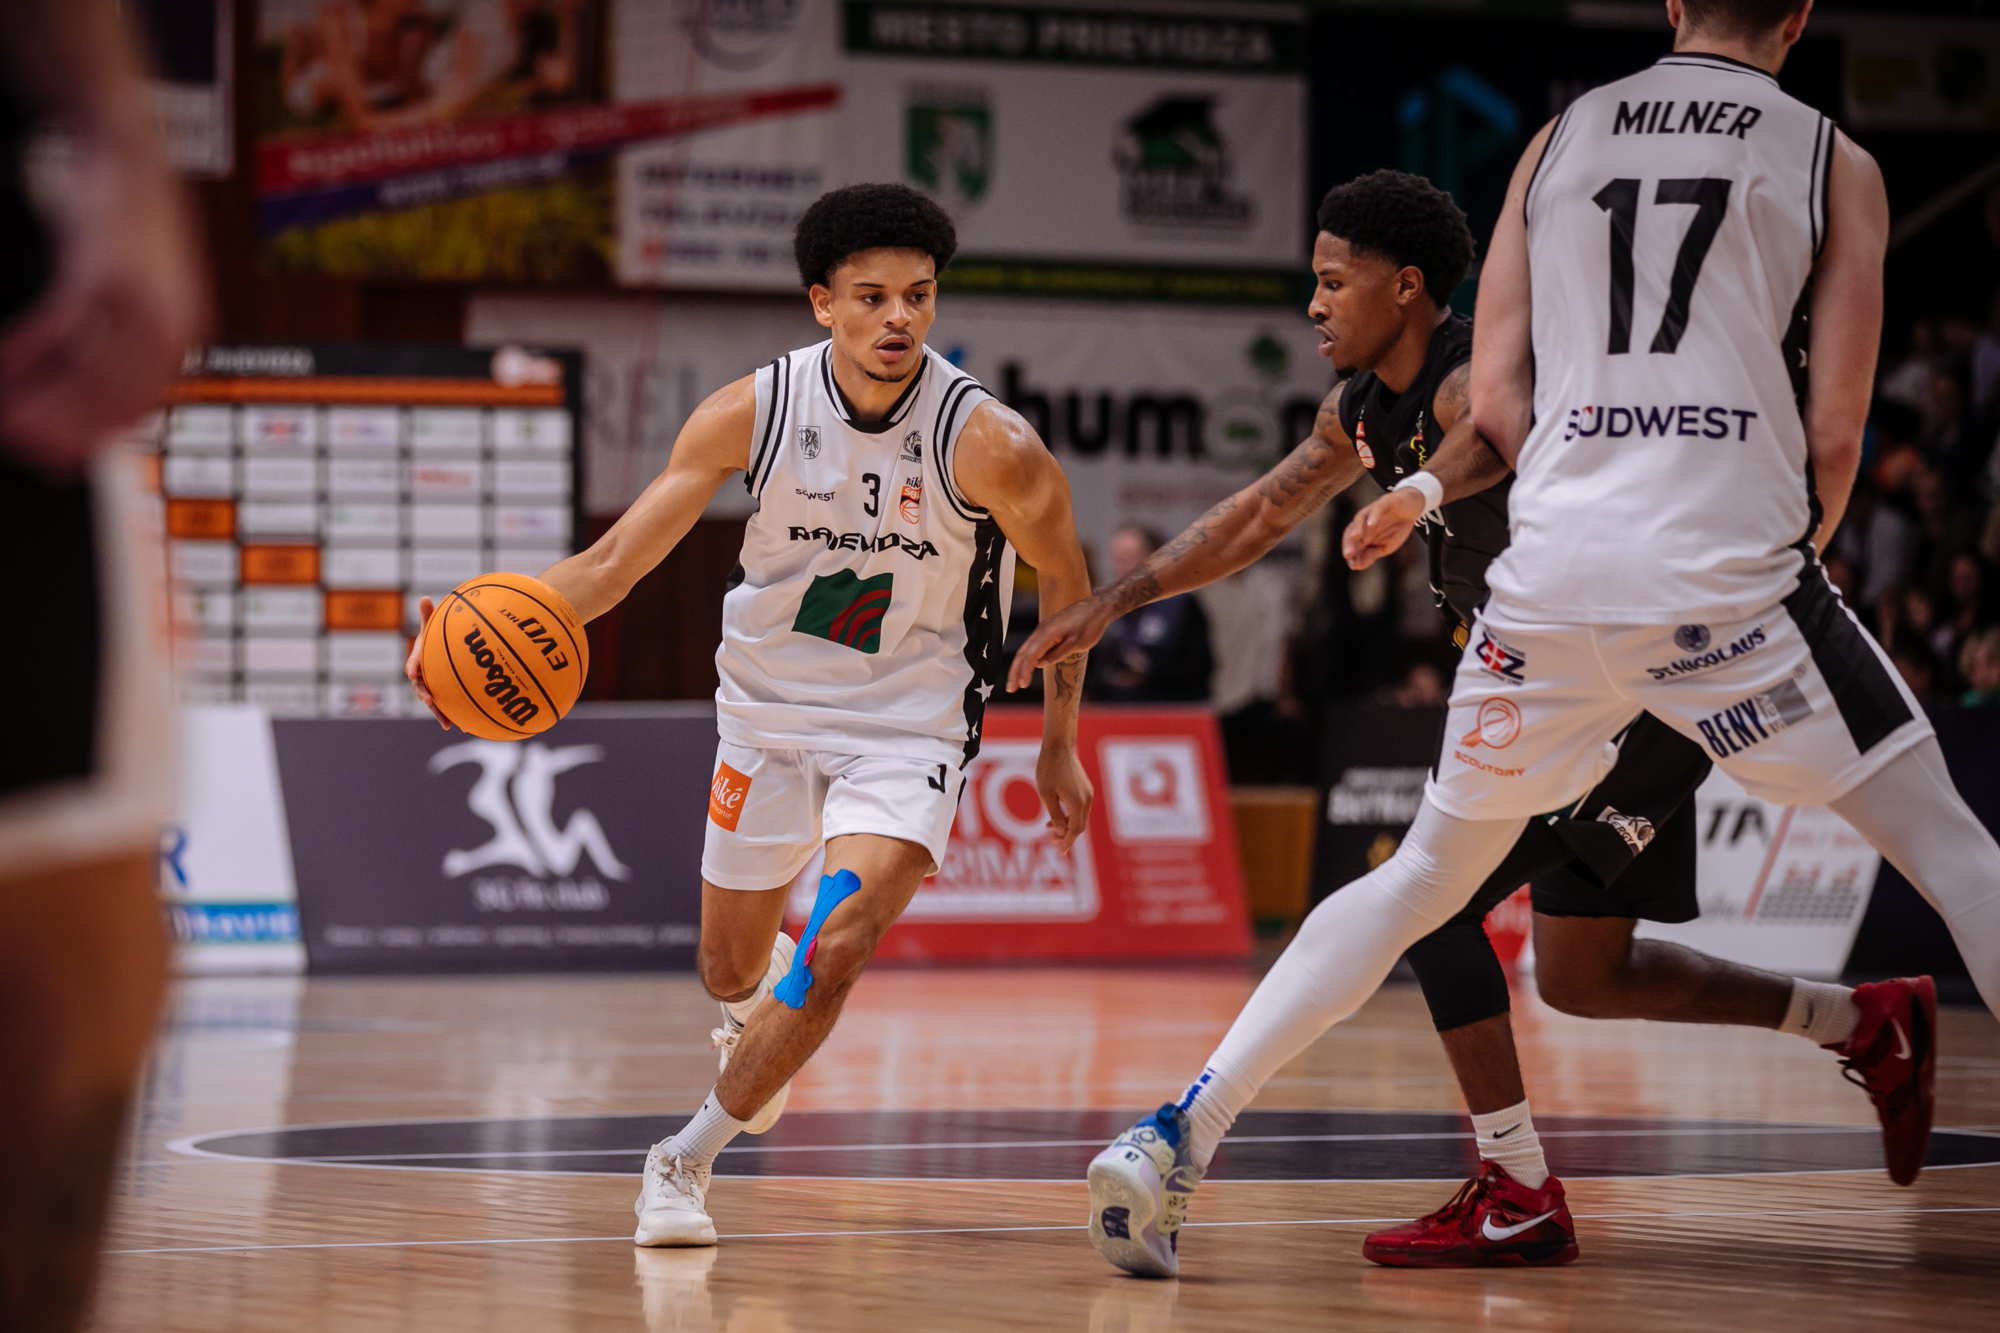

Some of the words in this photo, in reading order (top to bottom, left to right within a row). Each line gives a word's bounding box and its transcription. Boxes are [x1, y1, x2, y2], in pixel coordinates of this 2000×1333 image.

[871, 8, 1029, 51] MESTO
[1036, 17, 1275, 64] PRIEVIDZA
[1612, 101, 1762, 140] MILNER
[1592, 178, 1733, 355] 17
[862, 473, 880, 517] 3
[499, 608, 520, 623] NXT
[516, 617, 569, 672] EVO
[463, 626, 539, 727] Wilson
[1696, 697, 1770, 759] BENY
[1454, 750, 1527, 778] SCOUTORY
